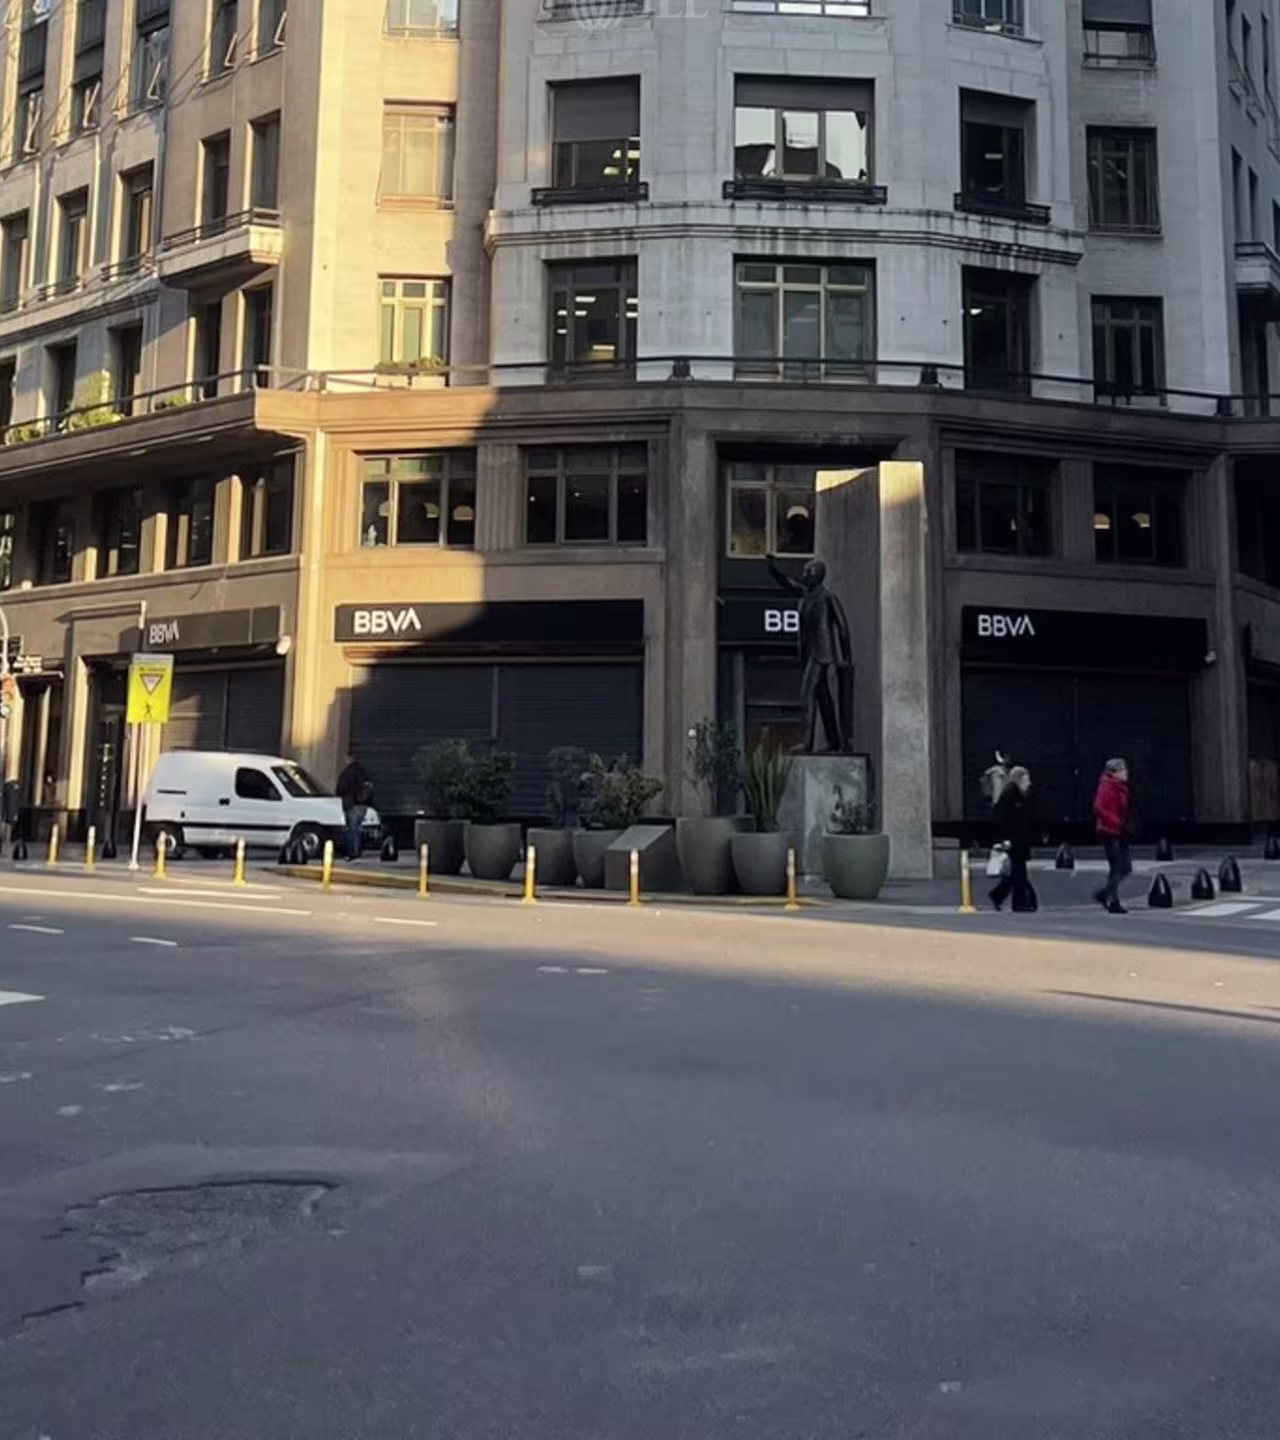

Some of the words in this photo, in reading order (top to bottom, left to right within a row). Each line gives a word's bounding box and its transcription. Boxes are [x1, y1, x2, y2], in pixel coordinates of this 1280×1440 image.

[149, 619, 180, 644] BBVA
[353, 607, 422, 635] BBVA
[764, 609, 800, 632] BB
[977, 614, 1036, 637] BBVA
